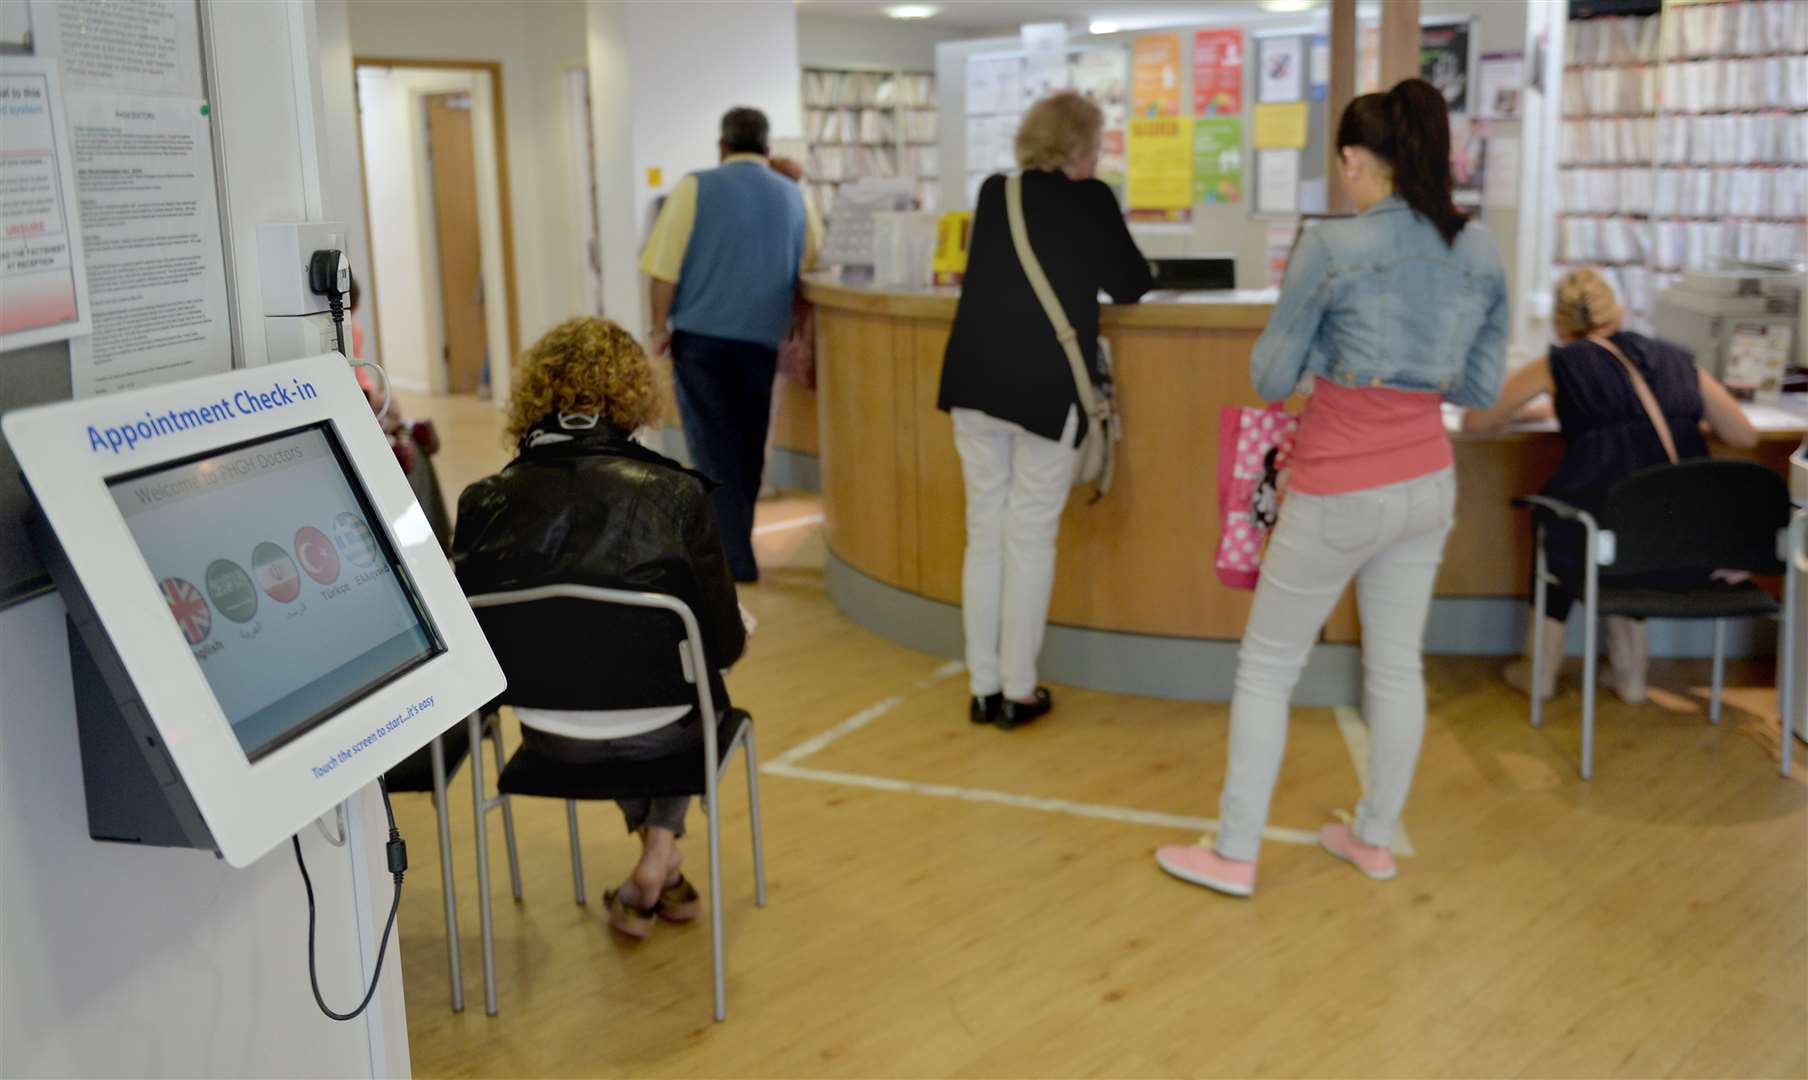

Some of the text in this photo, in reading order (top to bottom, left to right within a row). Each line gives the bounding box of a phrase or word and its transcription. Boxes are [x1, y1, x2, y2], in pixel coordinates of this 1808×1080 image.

[23, 87, 41, 98] this
[17, 257, 54, 268] RECEPTION
[87, 378, 318, 454] Appointment Check-in
[133, 446, 304, 504] Welcome to PHGH Doctors
[312, 756, 338, 778] Touch
[337, 748, 353, 764] the
[352, 732, 378, 754] screen
[376, 727, 386, 739] to
[418, 696, 435, 713] easy
